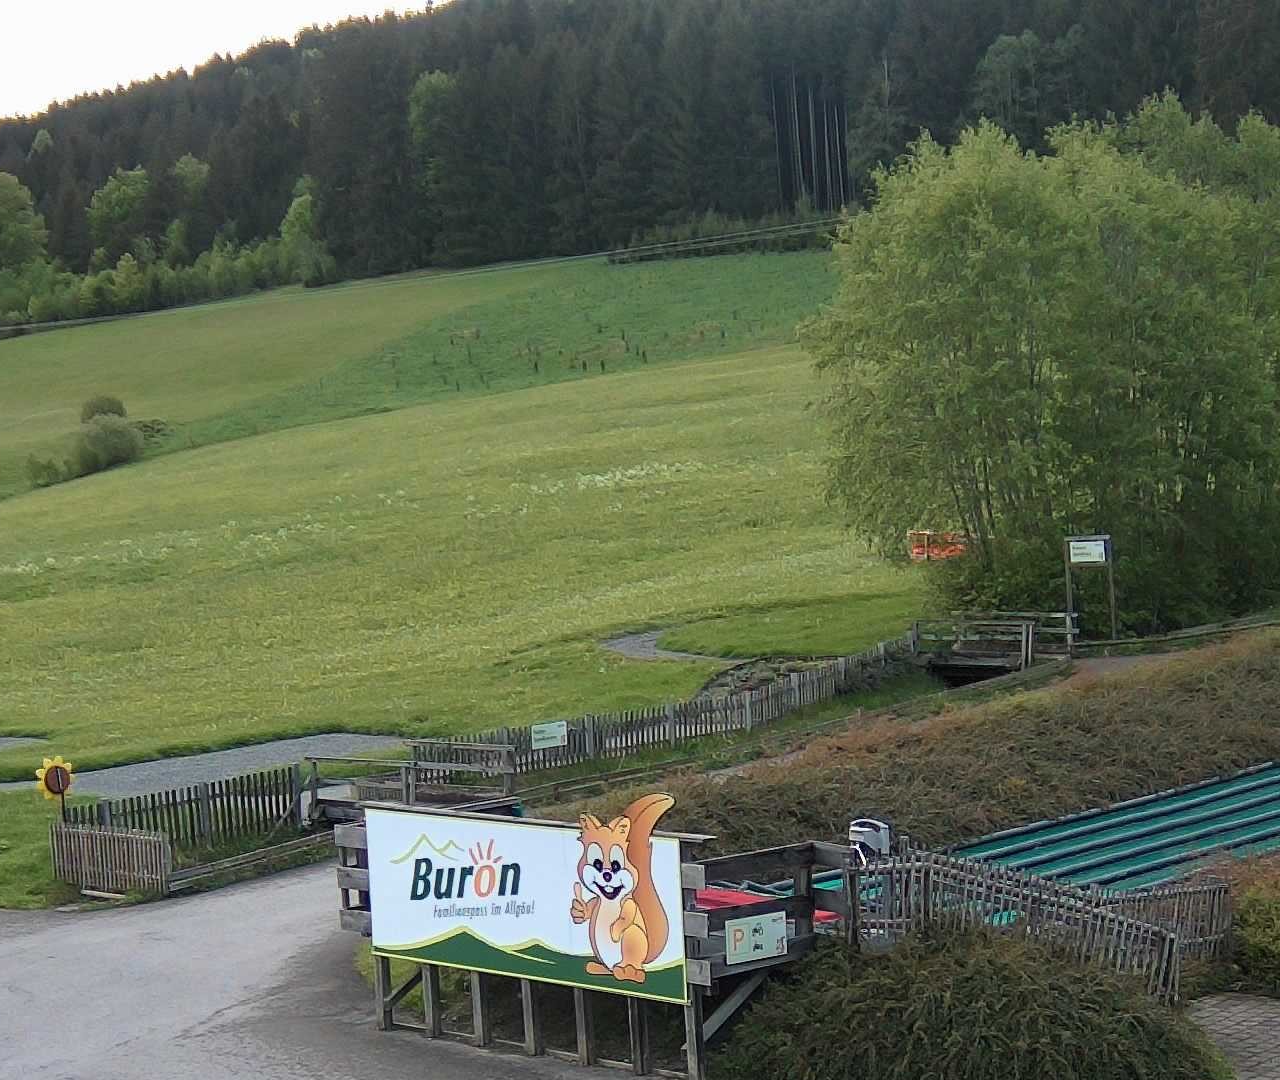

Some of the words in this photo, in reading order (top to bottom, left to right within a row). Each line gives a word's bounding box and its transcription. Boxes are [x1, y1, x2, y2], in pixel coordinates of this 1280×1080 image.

[410, 857, 521, 900] Buron
[491, 902, 501, 915] im
[733, 928, 745, 952] P
